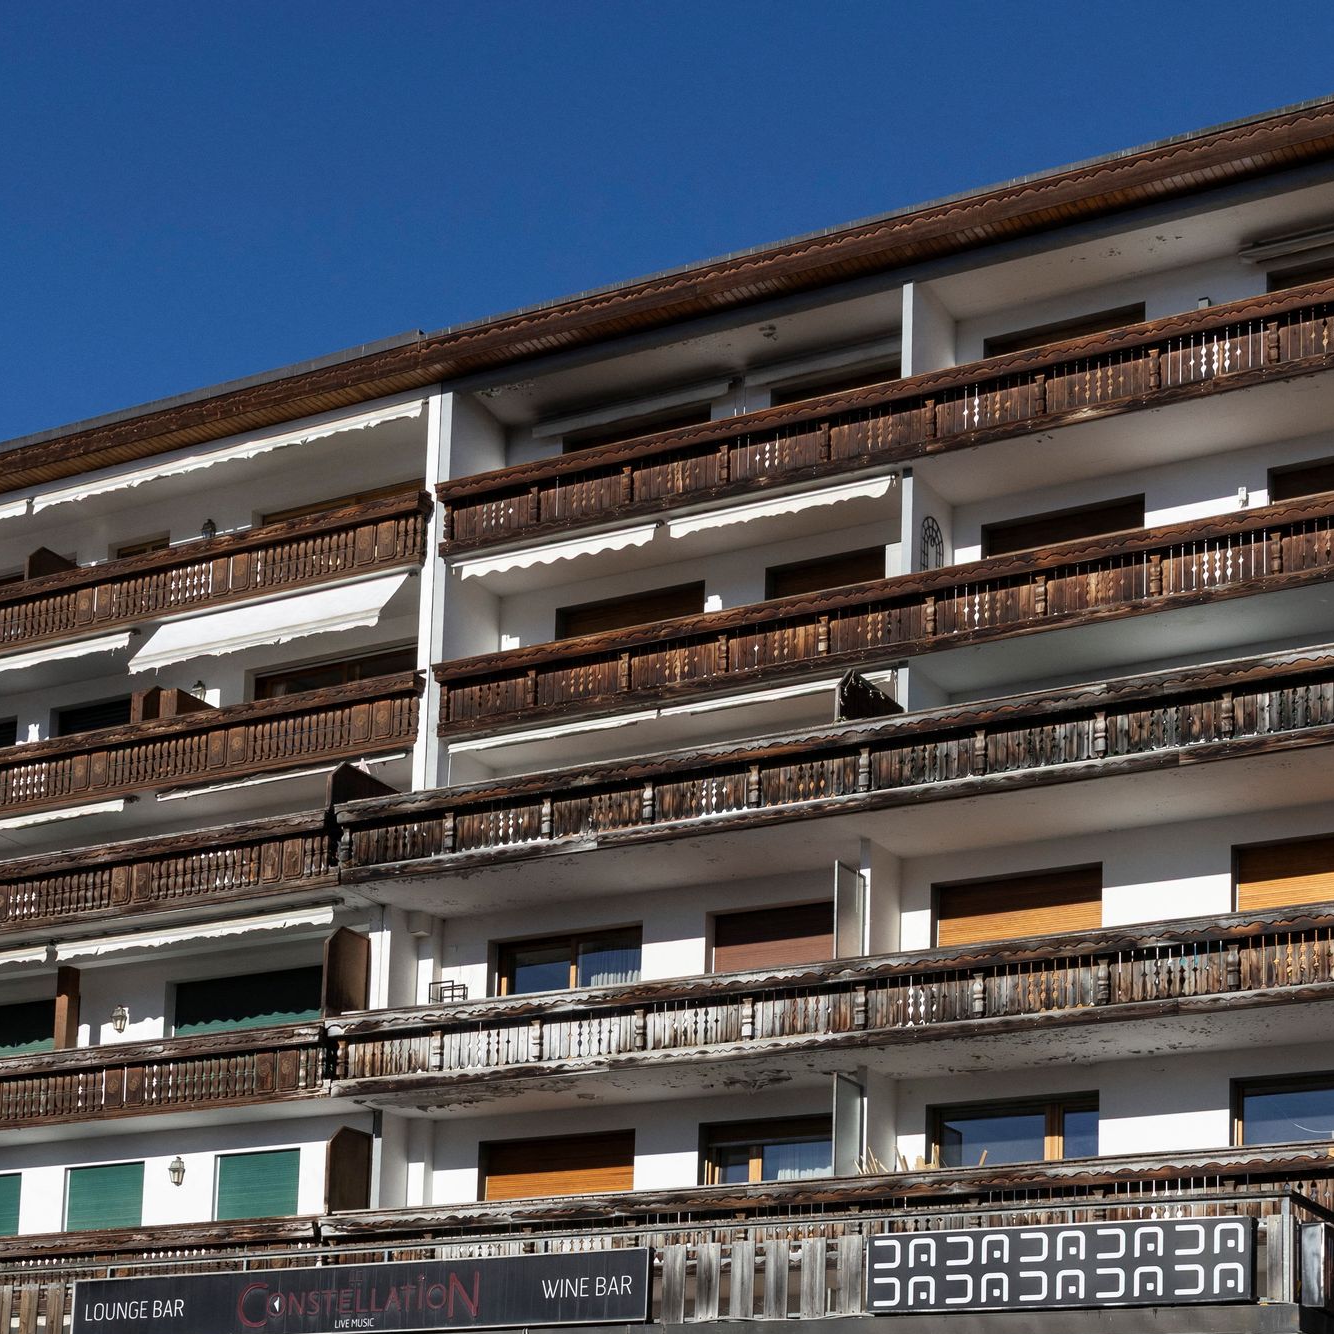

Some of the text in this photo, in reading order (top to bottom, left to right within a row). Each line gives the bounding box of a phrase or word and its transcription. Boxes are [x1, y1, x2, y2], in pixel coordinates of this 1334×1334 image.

[541, 1275, 632, 1299] WINE BAR
[85, 1299, 184, 1322] LOUNGE BAR
[334, 1318, 374, 1329] LIVE MUSIC
